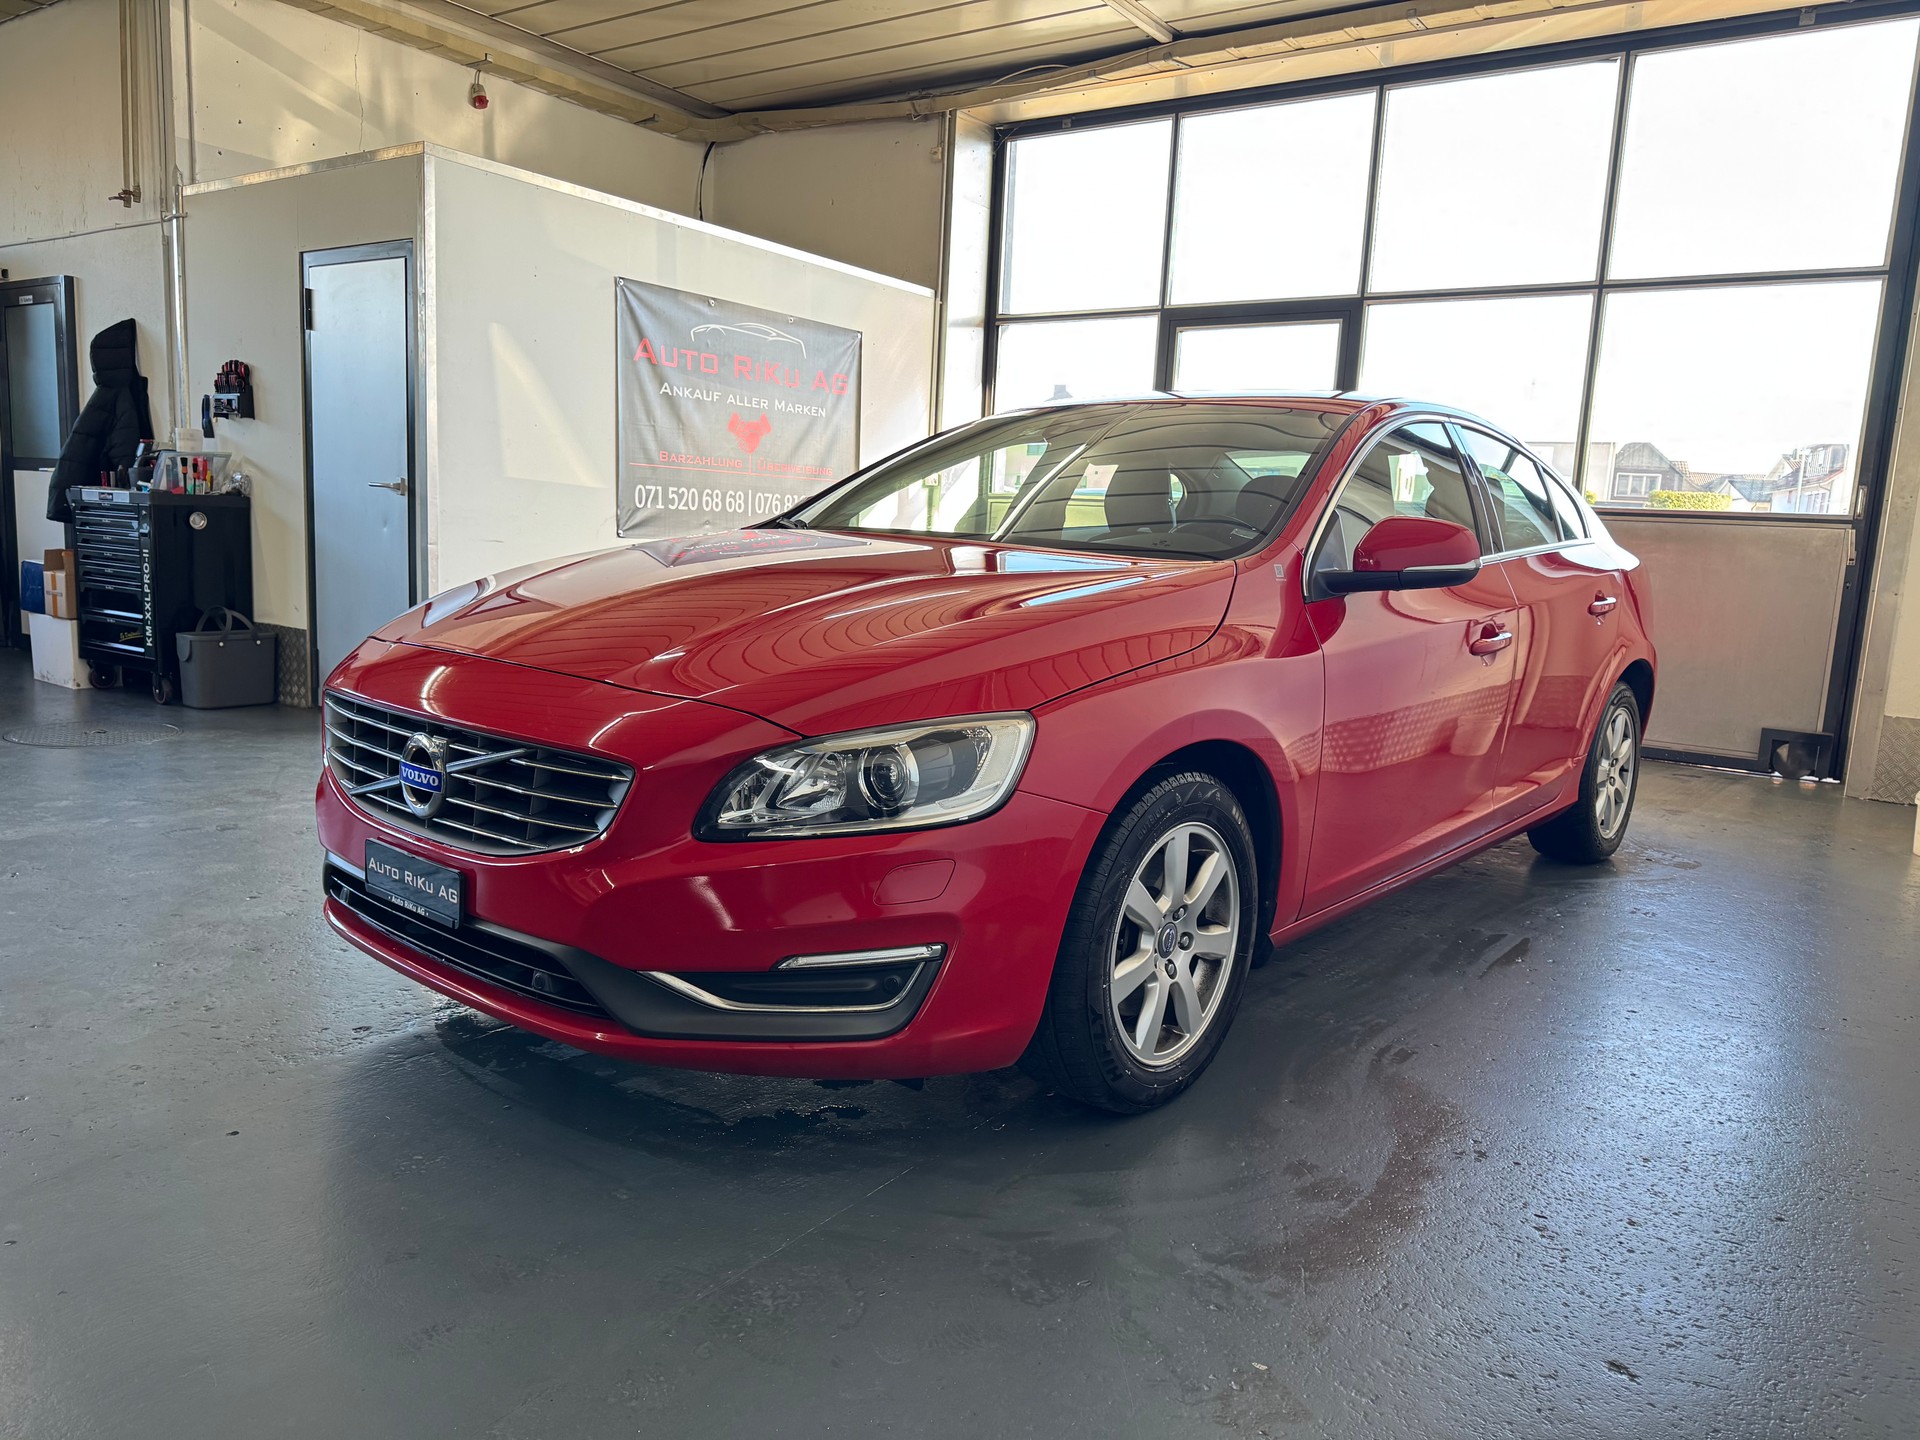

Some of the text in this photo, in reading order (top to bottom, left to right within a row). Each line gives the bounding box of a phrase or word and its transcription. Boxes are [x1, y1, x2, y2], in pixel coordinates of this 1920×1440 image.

[811, 370, 849, 395] AG
[659, 382, 826, 418] ANKAUF ALLER MARKEN
[659, 451, 743, 469] BARZAHLUNG
[635, 484, 664, 509] 071
[668, 486, 698, 511] 520
[702, 489, 722, 512] 68
[725, 490, 745, 513] 68
[755, 492, 781, 515] 076
[142, 548, 153, 647] KM-XXLPRO-II
[401, 766, 439, 787] VOLVO
[391, 896, 403, 907] Auto
[417, 908, 425, 916] AG
[438, 885, 458, 904] AG
